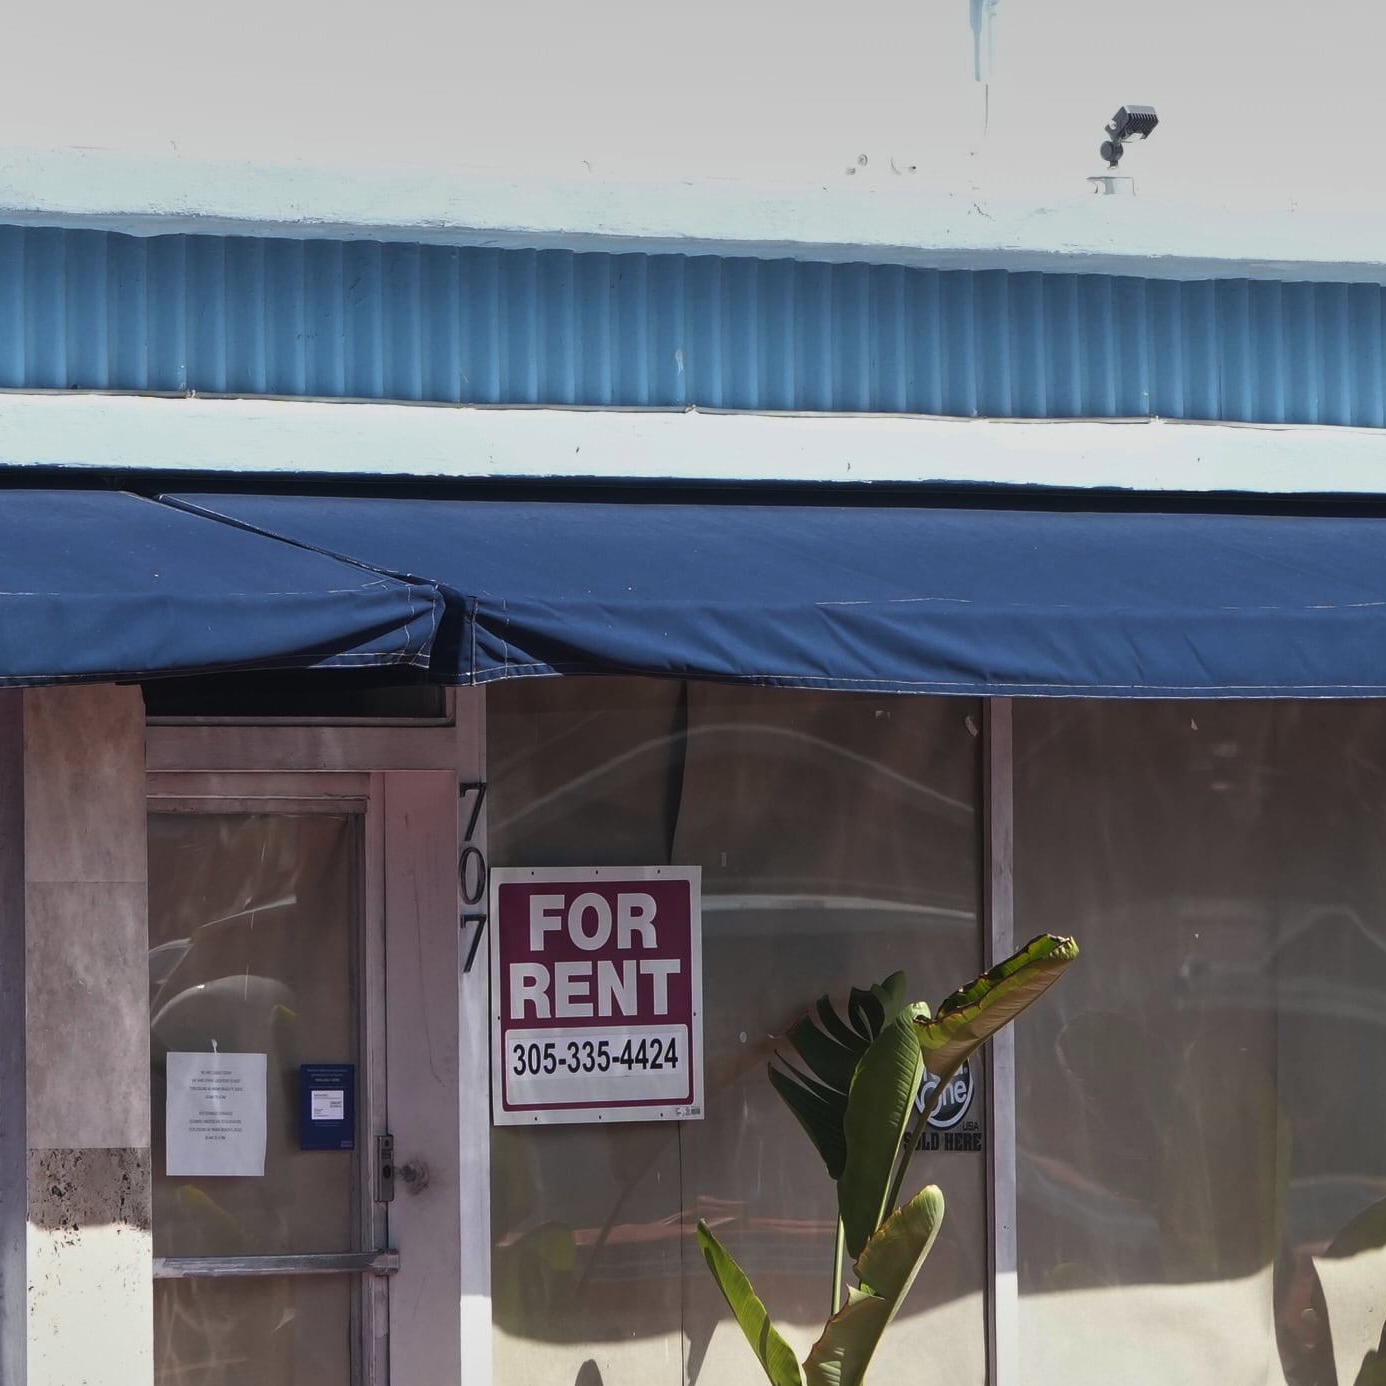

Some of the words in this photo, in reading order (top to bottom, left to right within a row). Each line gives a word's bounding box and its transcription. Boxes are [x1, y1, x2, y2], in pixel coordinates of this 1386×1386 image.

[459, 782, 487, 973] 707
[529, 892, 658, 951] FOR
[509, 958, 681, 1020] RENT
[512, 1037, 679, 1076] 305-335-4424
[903, 1132, 940, 1151] SLD
[944, 1132, 982, 1151] HERE
